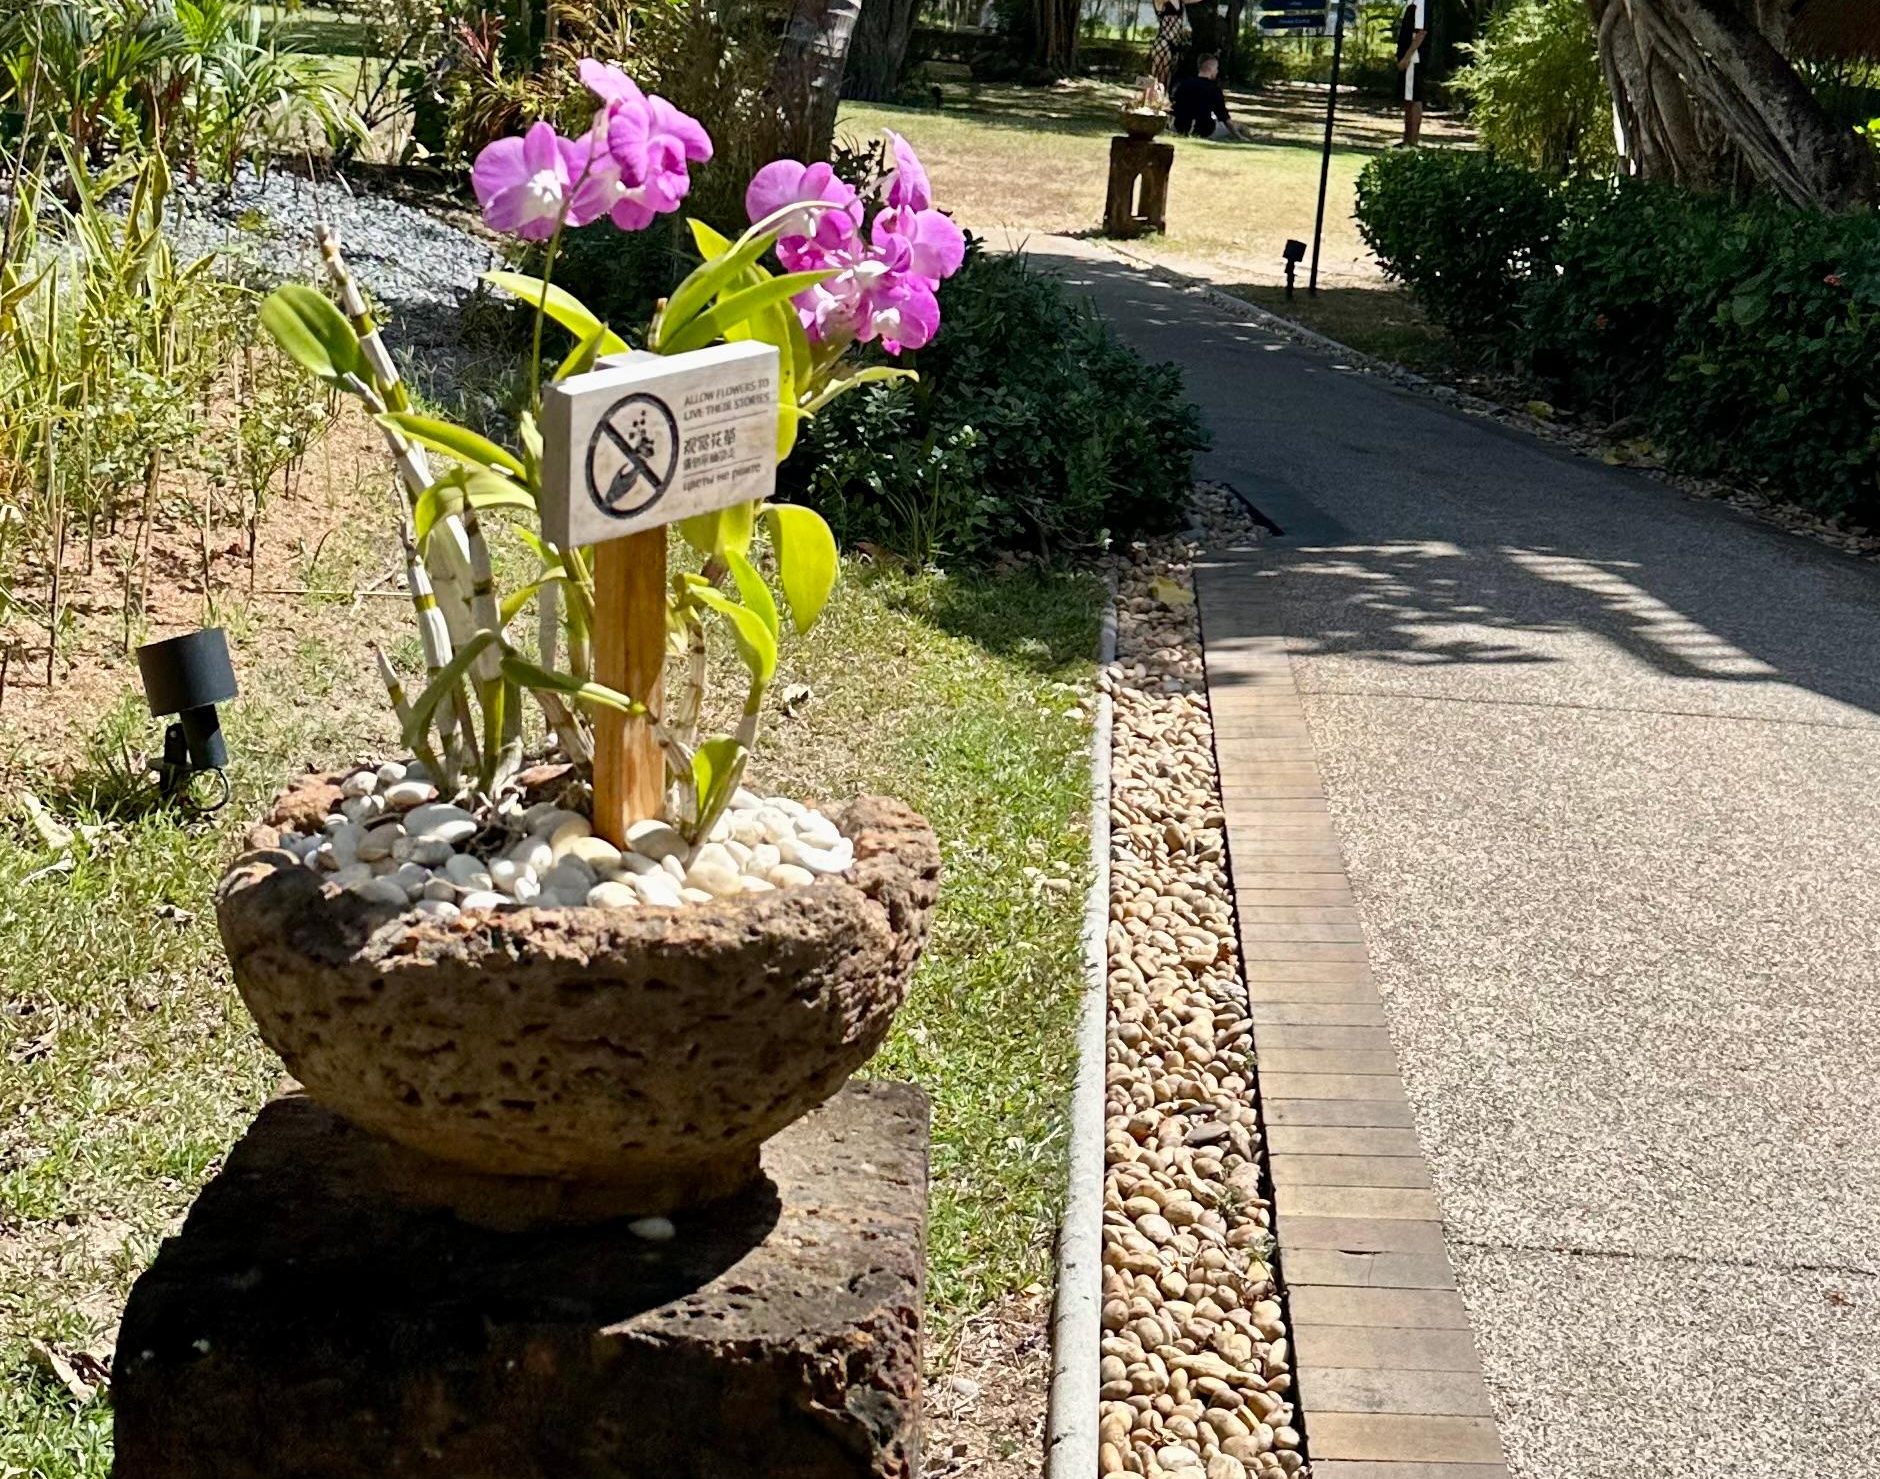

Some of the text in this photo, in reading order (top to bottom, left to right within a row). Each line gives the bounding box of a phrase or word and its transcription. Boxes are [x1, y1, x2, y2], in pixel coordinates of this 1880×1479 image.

[684, 378, 769, 406] ALLOW FLOWERS TO
[683, 393, 769, 421] LIVE THEIR STORIES
